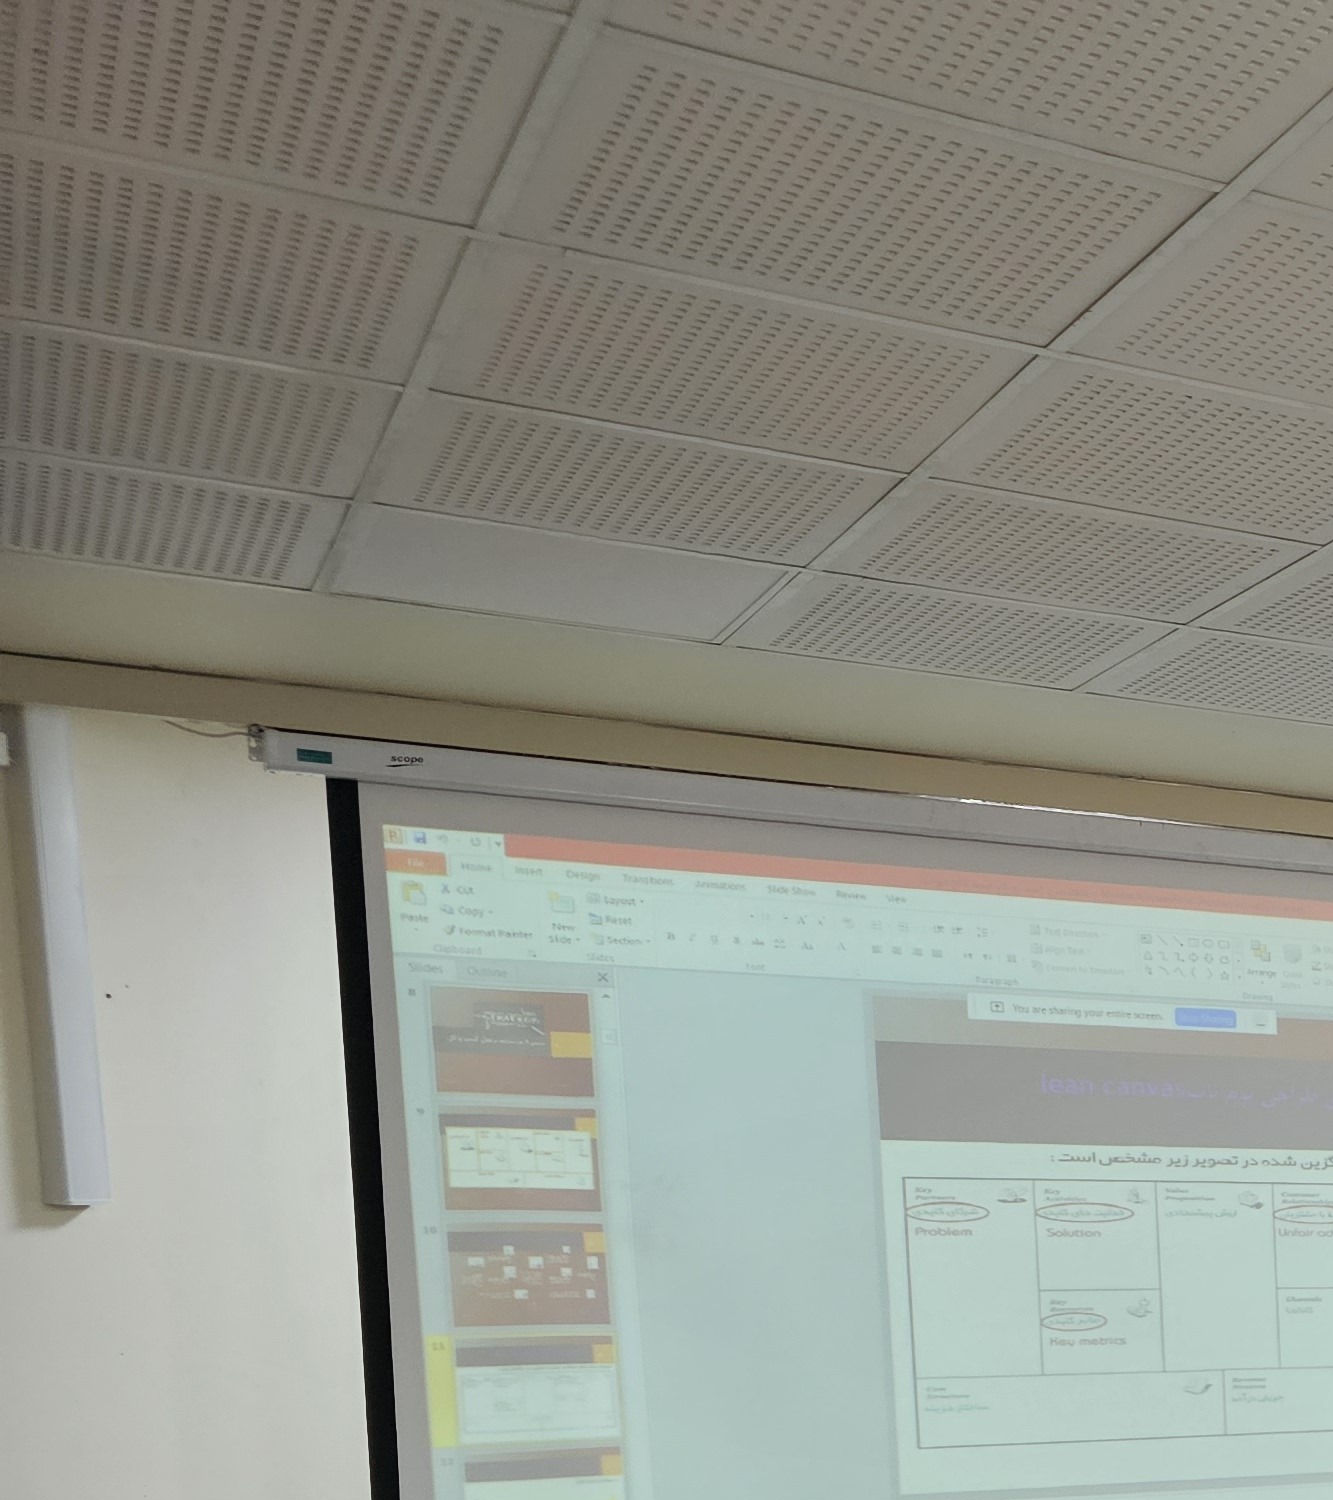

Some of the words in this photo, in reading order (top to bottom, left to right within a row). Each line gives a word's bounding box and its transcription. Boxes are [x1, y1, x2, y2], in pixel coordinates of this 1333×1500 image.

[390, 755, 424, 765] scope
[460, 861, 493, 872] Home
[514, 866, 544, 877] Insert
[566, 870, 600, 883] Design
[622, 873, 674, 887] Transitions
[456, 886, 474, 895] Cut
[836, 889, 866, 900] Review
[458, 906, 484, 919] Copy
[604, 916, 632, 926] Reset
[459, 926, 496, 938] Format
[408, 962, 444, 974] Slides
[466, 966, 508, 978] Outline
[1013, 1003, 1030, 1014] You
[1031, 1006, 1046, 1015] are
[1049, 1005, 1082, 1018] sharing
[1085, 1009, 1104, 1020] your
[1106, 1008, 1132, 1019] entire
[1040, 1072, 1093, 1095] lean
[1102, 1078, 1186, 1099] canvas
[1058, 1152, 1096, 1163] است
[1099, 1152, 1161, 1166] مشخص
[1166, 1154, 1188, 1168] زیر
[1192, 1156, 1239, 1168] تصویر
[1241, 1158, 1259, 1168] در
[1261, 1156, 1297, 1166] شده
[915, 1226, 972, 1238] Problem
[1046, 1228, 1102, 1239] Solution
[1278, 1228, 1314, 1238] Unfair
[1050, 1336, 1074, 1348] Key
[1079, 1336, 1126, 1346] metrics
